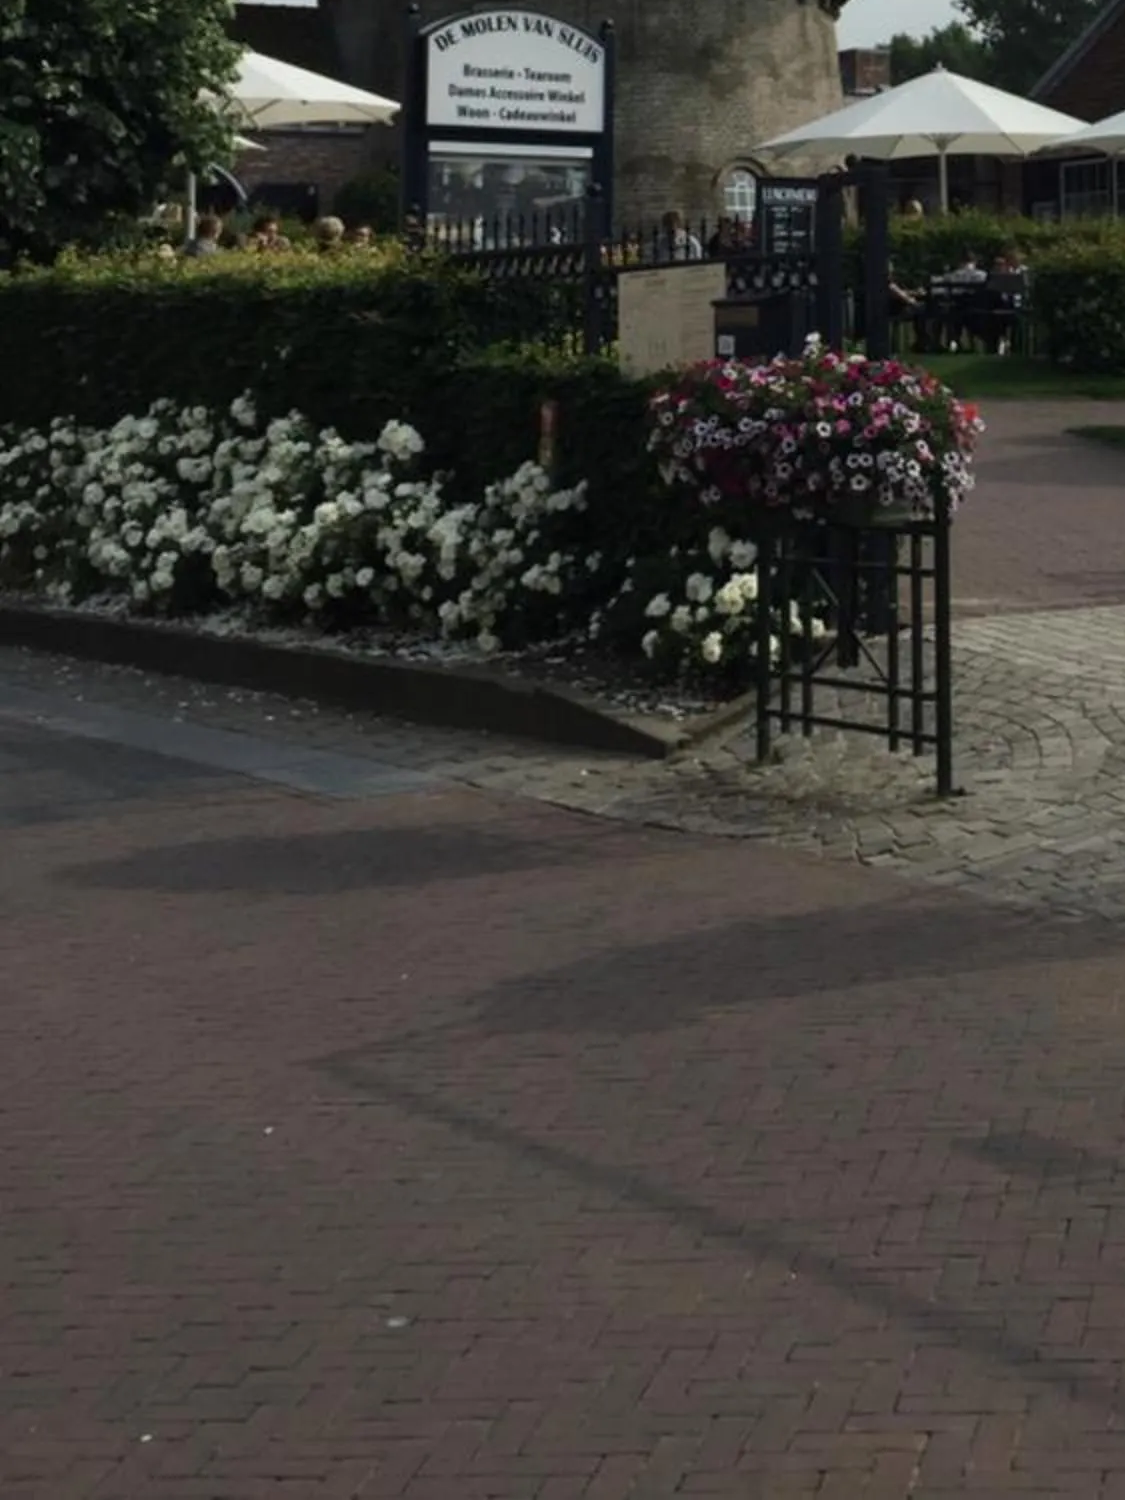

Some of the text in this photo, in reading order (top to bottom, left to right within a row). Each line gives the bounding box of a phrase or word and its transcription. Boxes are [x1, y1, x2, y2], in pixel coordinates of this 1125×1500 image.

[433, 14, 601, 65] DE MOLEN VAN SLUIS
[463, 63, 514, 80] Brasserie
[524, 67, 572, 84] Tearoom
[448, 83, 586, 104] Dames Accessoire Winkel
[456, 105, 490, 120] Woon
[498, 106, 577, 124] Cadeauwinkel
